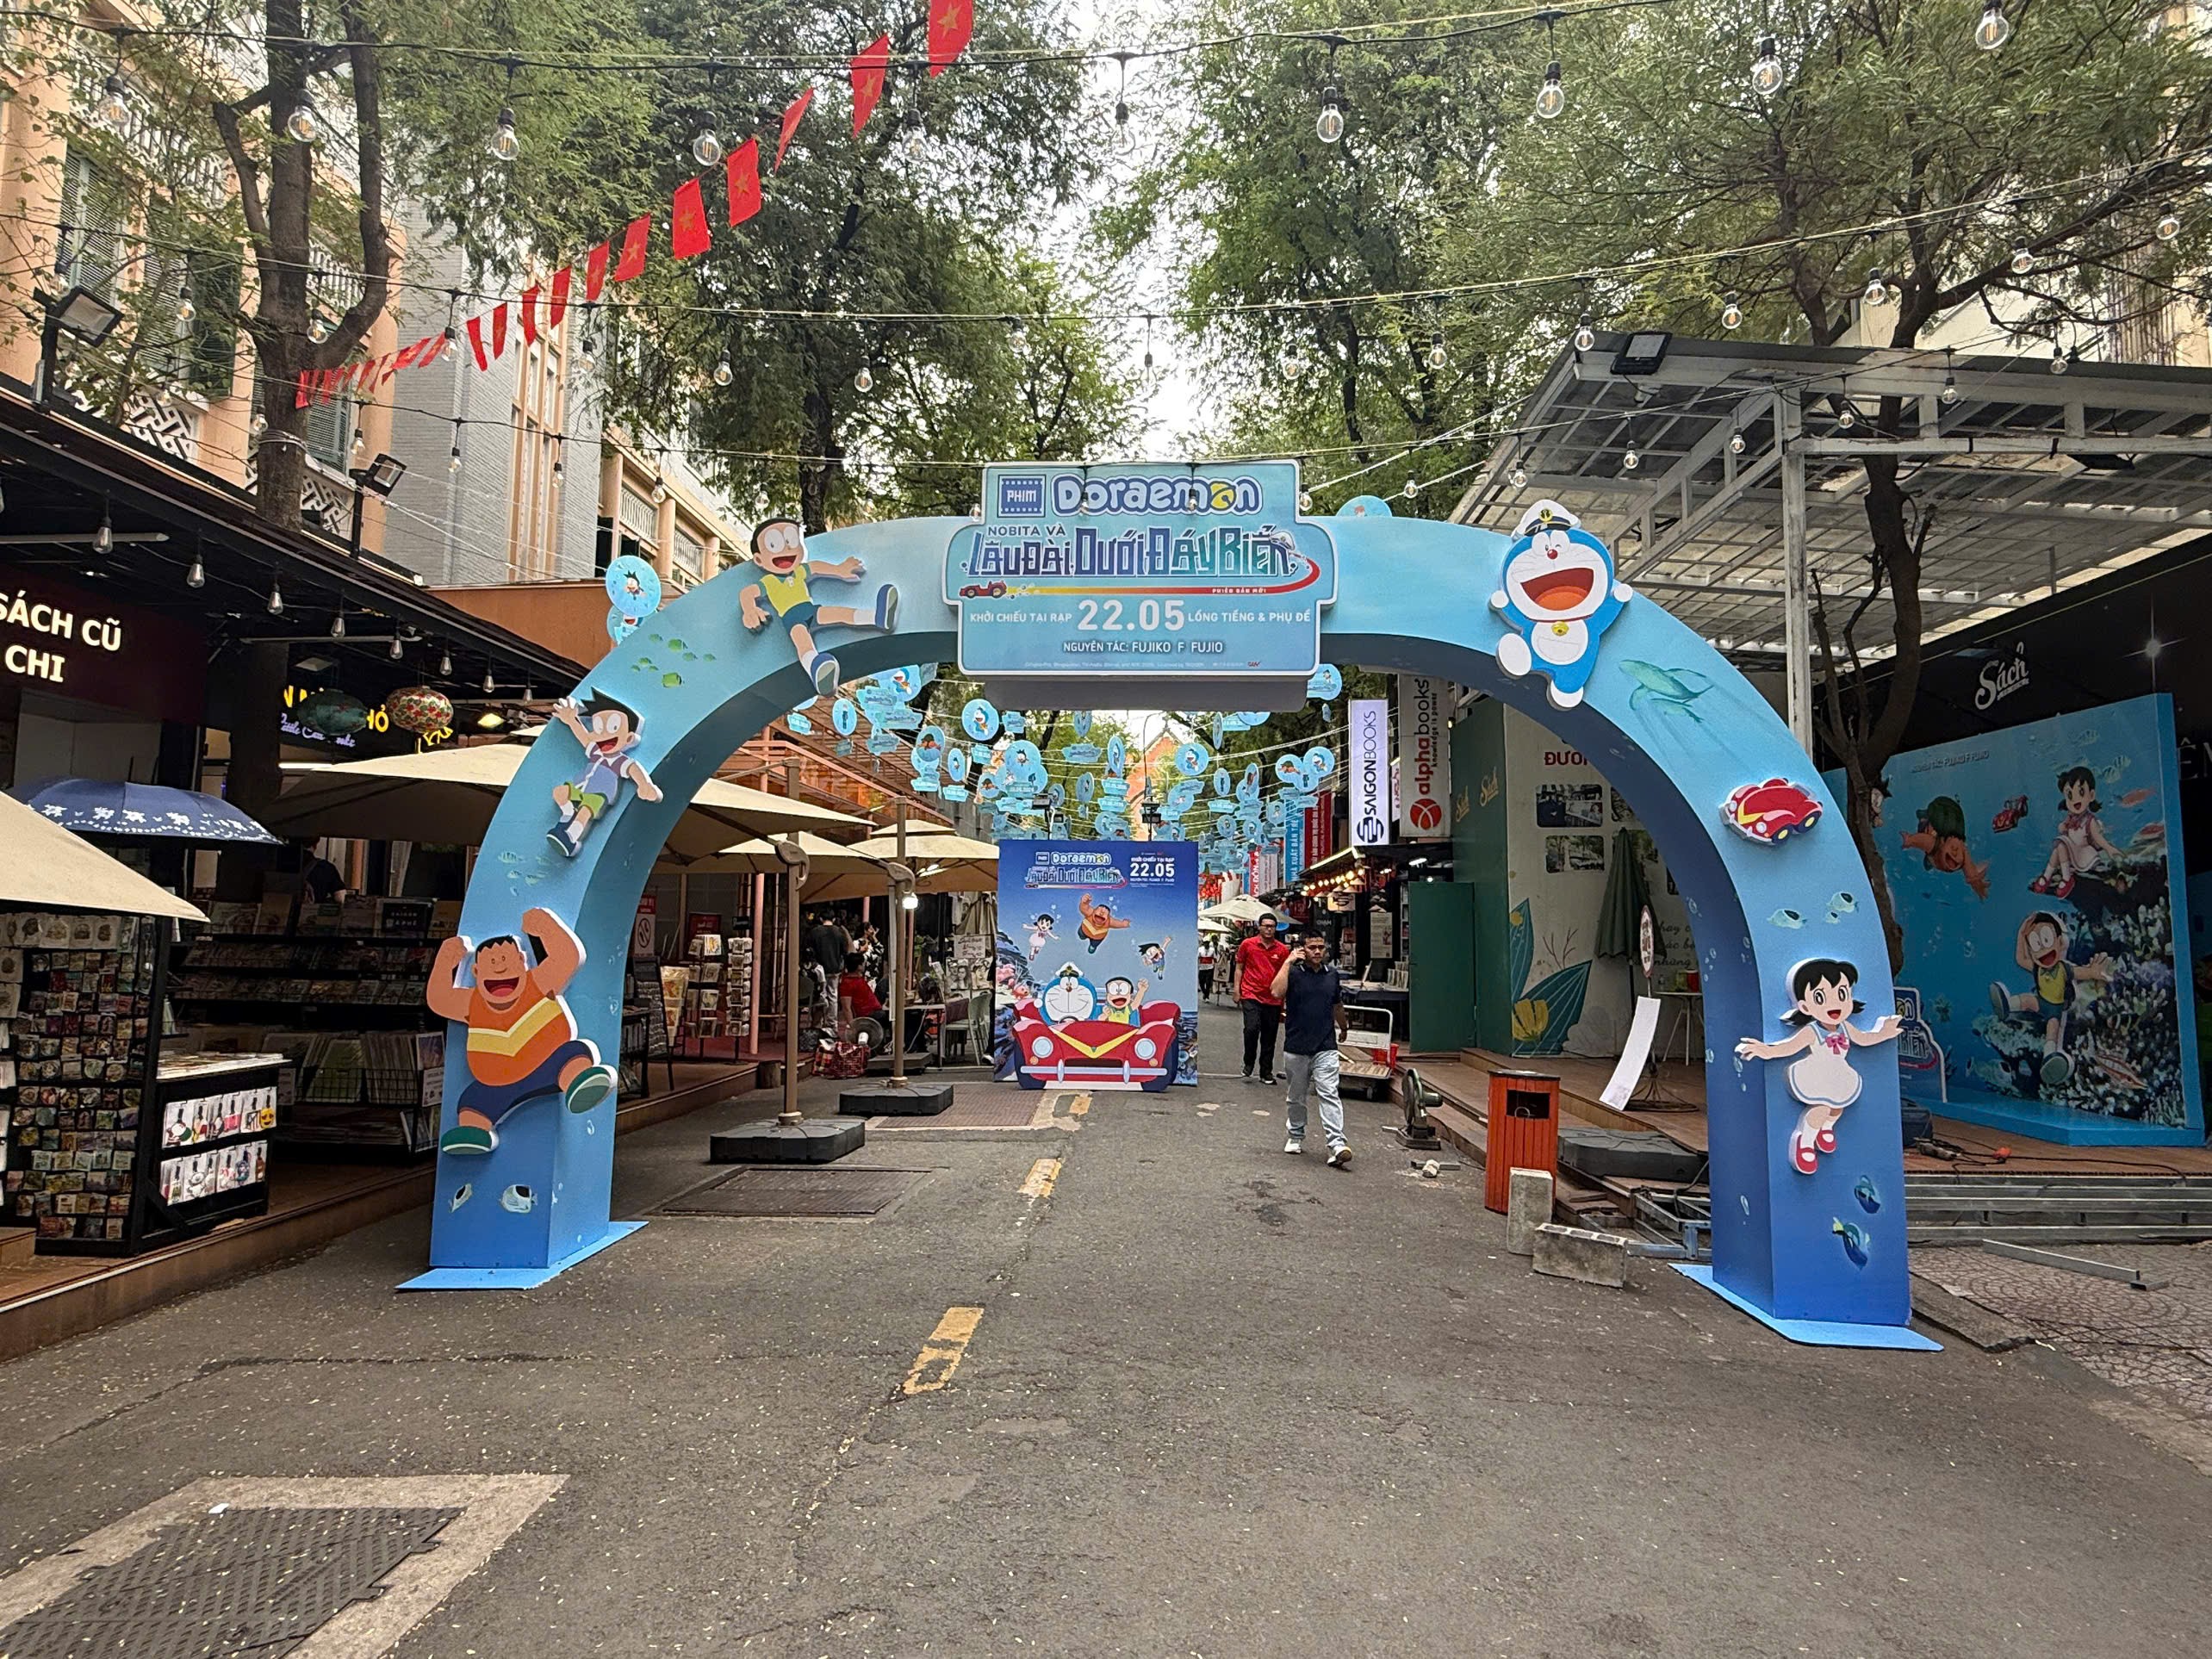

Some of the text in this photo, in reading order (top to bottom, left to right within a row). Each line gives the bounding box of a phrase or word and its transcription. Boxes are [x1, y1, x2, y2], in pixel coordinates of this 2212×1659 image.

[1006, 490, 1037, 503] PHIM
[1052, 475, 1261, 515] Doraemon
[988, 523, 1066, 537] NOBITA VÀ
[970, 611, 994, 622] KHỞI
[996, 610, 1027, 622] CHIẾU
[1050, 612, 1072, 624] RẠP
[1078, 600, 1185, 631] 22.05
[1221, 609, 1255, 622] TIẾNG
[1258, 612, 1266, 622] &
[1269, 612, 1292, 624] PHỤ
[82, 618, 121, 651] CŨ
[1063, 640, 1223, 653] NGUYÊN TÁC: FUJIKO F FUJIO
[5, 644, 65, 683] CHI
[1975, 641, 2029, 710] Sách
[1414, 678, 1434, 795] alphabooks
[1364, 711, 1376, 816] SAIGONBOOKS
[1051, 851, 1111, 865] Doraemon
[1130, 862, 1175, 877] 22.05
